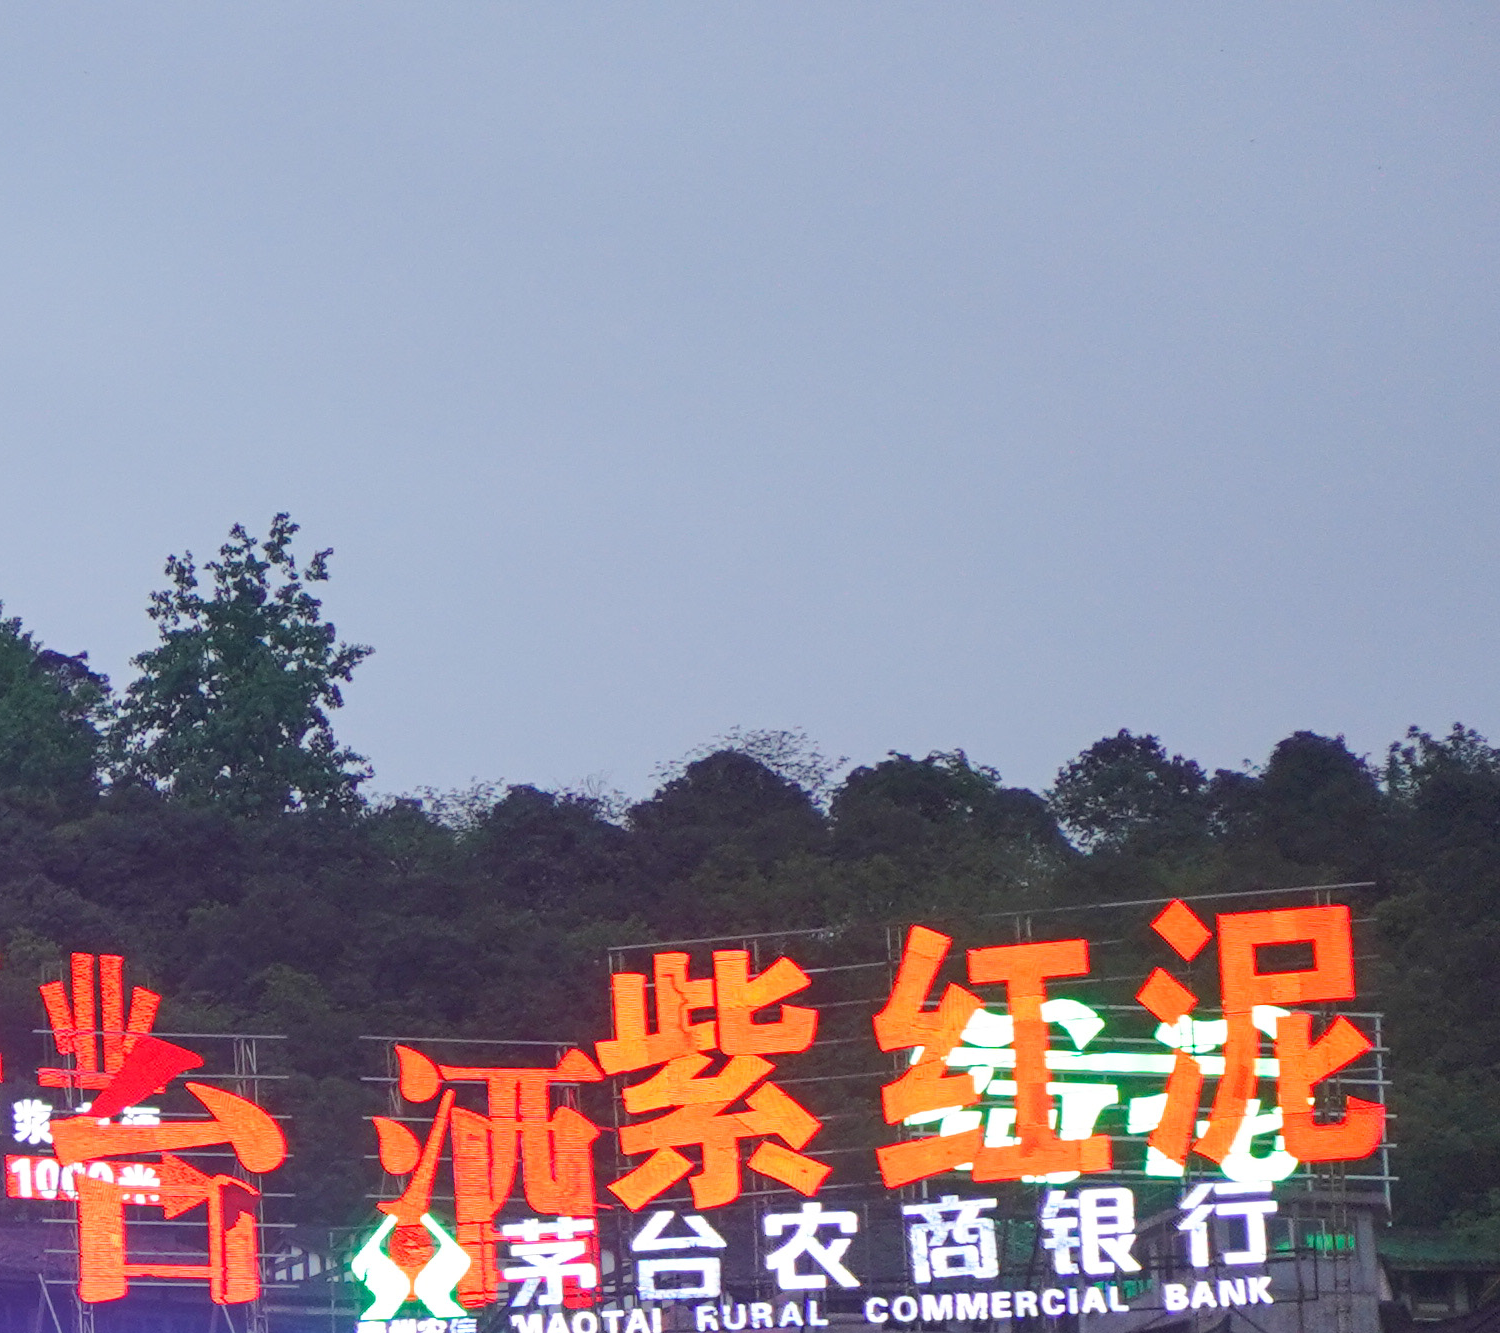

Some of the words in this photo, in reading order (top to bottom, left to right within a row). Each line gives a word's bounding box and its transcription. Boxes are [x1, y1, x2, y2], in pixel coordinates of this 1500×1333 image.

[595, 902, 1386, 1212] 紫红泥
[500, 1178, 1280, 1310] 茅台农商银行
[695, 1298, 831, 1333] RURAL
[864, 1284, 1131, 1325] COMMERCIAL
[1164, 1274, 1276, 1313] BANK
